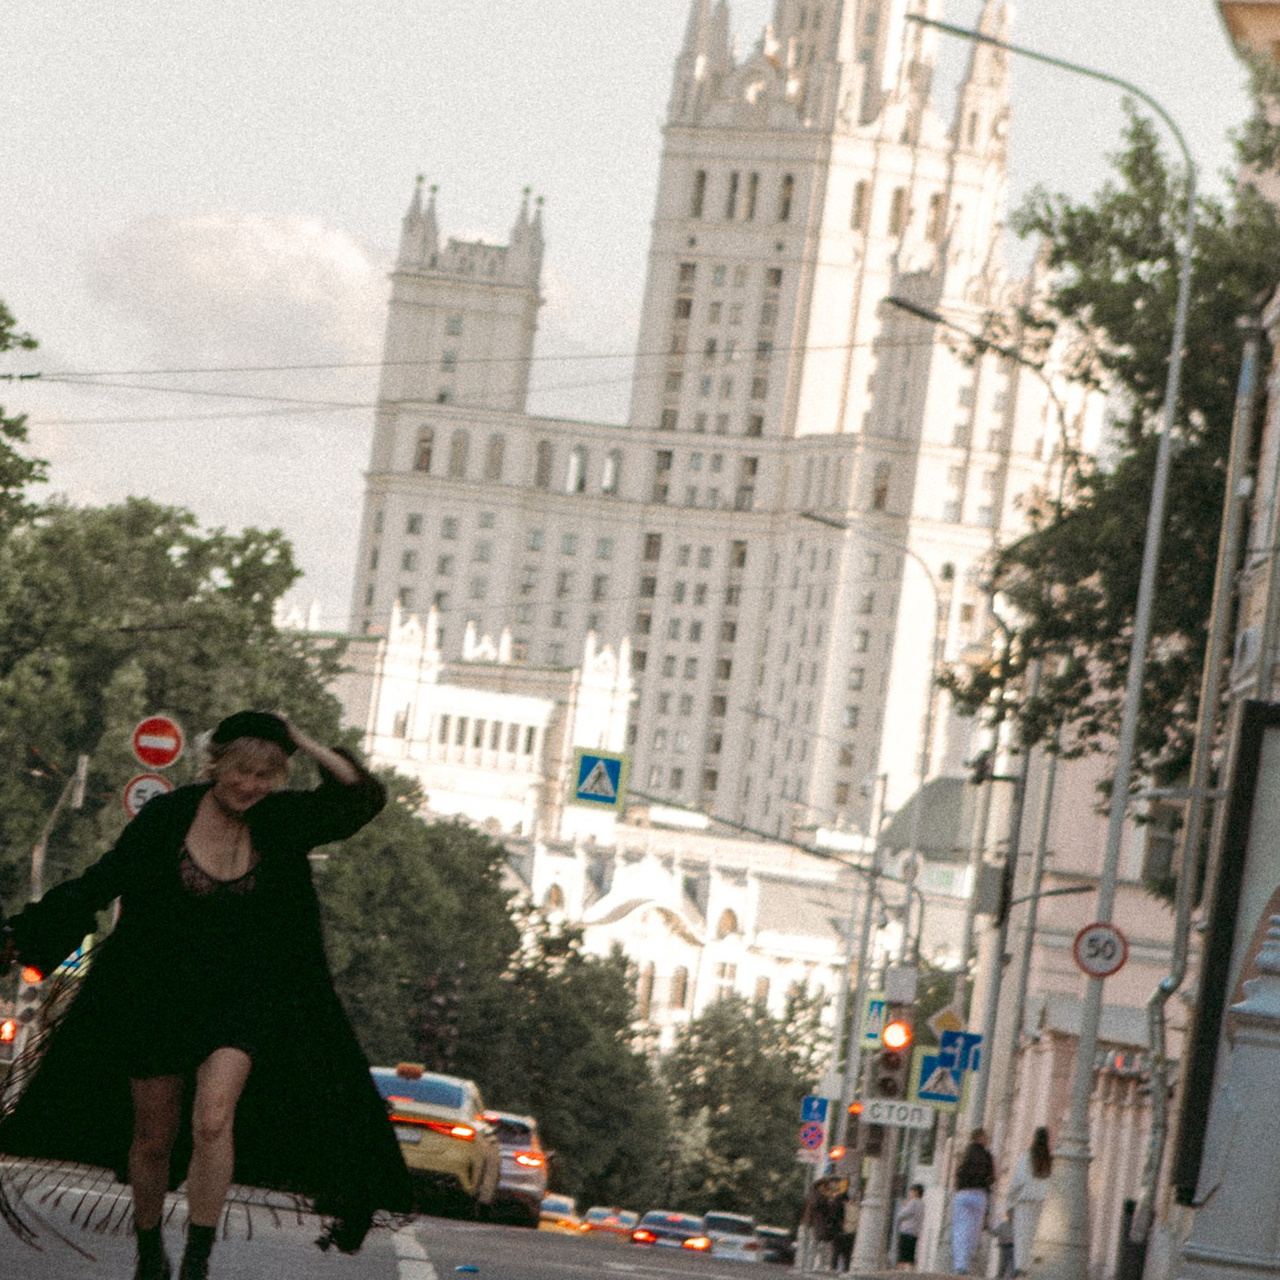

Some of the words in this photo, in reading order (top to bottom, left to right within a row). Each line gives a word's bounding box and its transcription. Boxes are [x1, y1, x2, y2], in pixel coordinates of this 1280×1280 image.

[134, 788, 161, 809] 5
[1086, 937, 1116, 960] 50
[870, 1102, 923, 1123] СТОП
